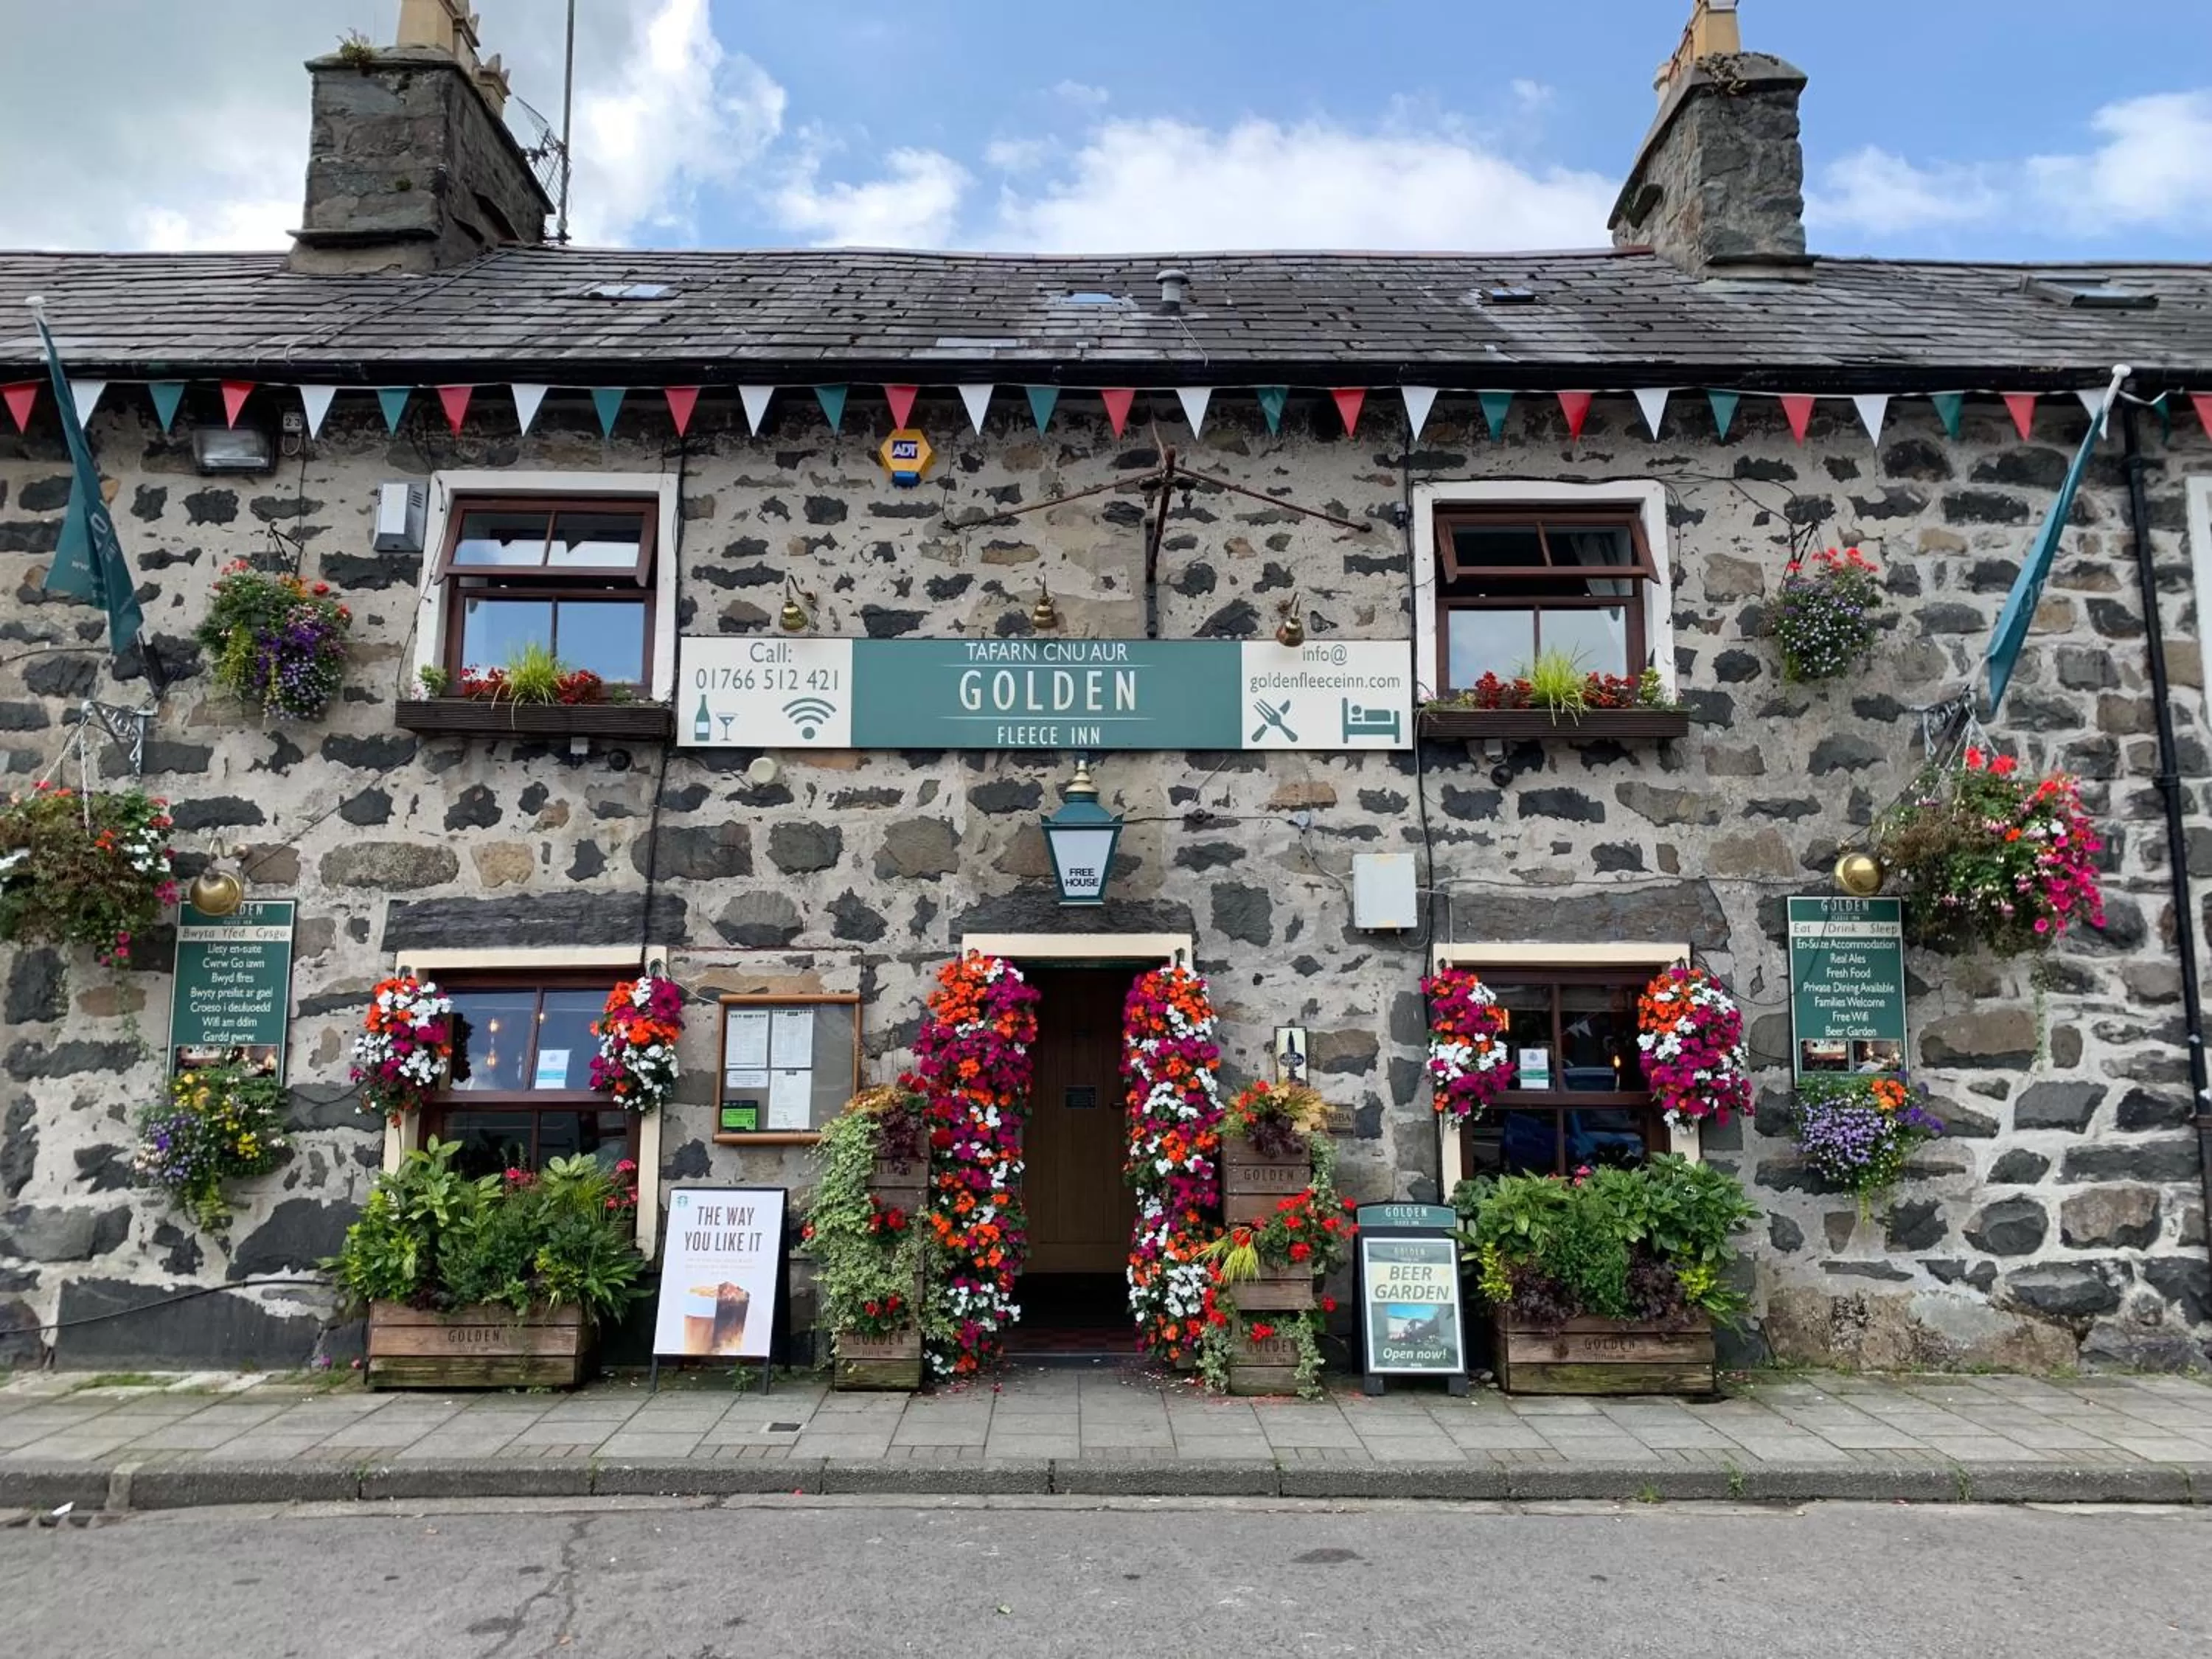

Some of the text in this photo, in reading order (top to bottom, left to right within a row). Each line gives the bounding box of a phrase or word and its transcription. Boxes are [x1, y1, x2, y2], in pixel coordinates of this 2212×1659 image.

[892, 443, 918, 456] ADT
[749, 641, 793, 663] Call:
[965, 642, 1129, 661] TAFARN CNU AUR
[1302, 644, 1347, 666] info@
[695, 668, 838, 690] 01766 512 421
[1250, 672, 1400, 693] goldenfleeceinn.com
[959, 669, 1135, 711] GOLDEN
[997, 726, 1100, 745] FLEECE INN
[1069, 868, 1095, 877] FREE
[1065, 877, 1099, 887] HOUSE
[1820, 899, 1870, 912] GOLDEN
[182, 928, 215, 939] Bwyta
[1793, 923, 1897, 936] Eat Drink Sleep
[1829, 938, 1896, 949] Accommodation
[202, 958, 229, 968] Cwrw
[1829, 953, 1866, 964] Real Ales
[211, 972, 234, 985] Bwyd
[1826, 967, 1871, 978] Fresh Food
[1803, 981, 1896, 995] Private Dining Available
[189, 1001, 221, 1012] Croeso
[1815, 996, 1885, 1008] Families Welcome
[222, 1018, 235, 1027] am
[1832, 1011, 1869, 1022] Free Wifi
[203, 1031, 229, 1042] Gardd
[1825, 1026, 1877, 1036] Beer Garden
[1244, 1168, 1294, 1181] GOLDEN
[697, 1206, 755, 1226] THE WAY
[1385, 1206, 1427, 1217] GOLDEN
[684, 1231, 762, 1252] YOU LIKE IT
[1390, 1265, 1433, 1281] BEER
[1374, 1284, 1449, 1300] GARDEN
[448, 1329, 501, 1343] GOLDEN
[1585, 1338, 1635, 1351] GOLDEN
[1382, 1348, 1447, 1361] Open now!
